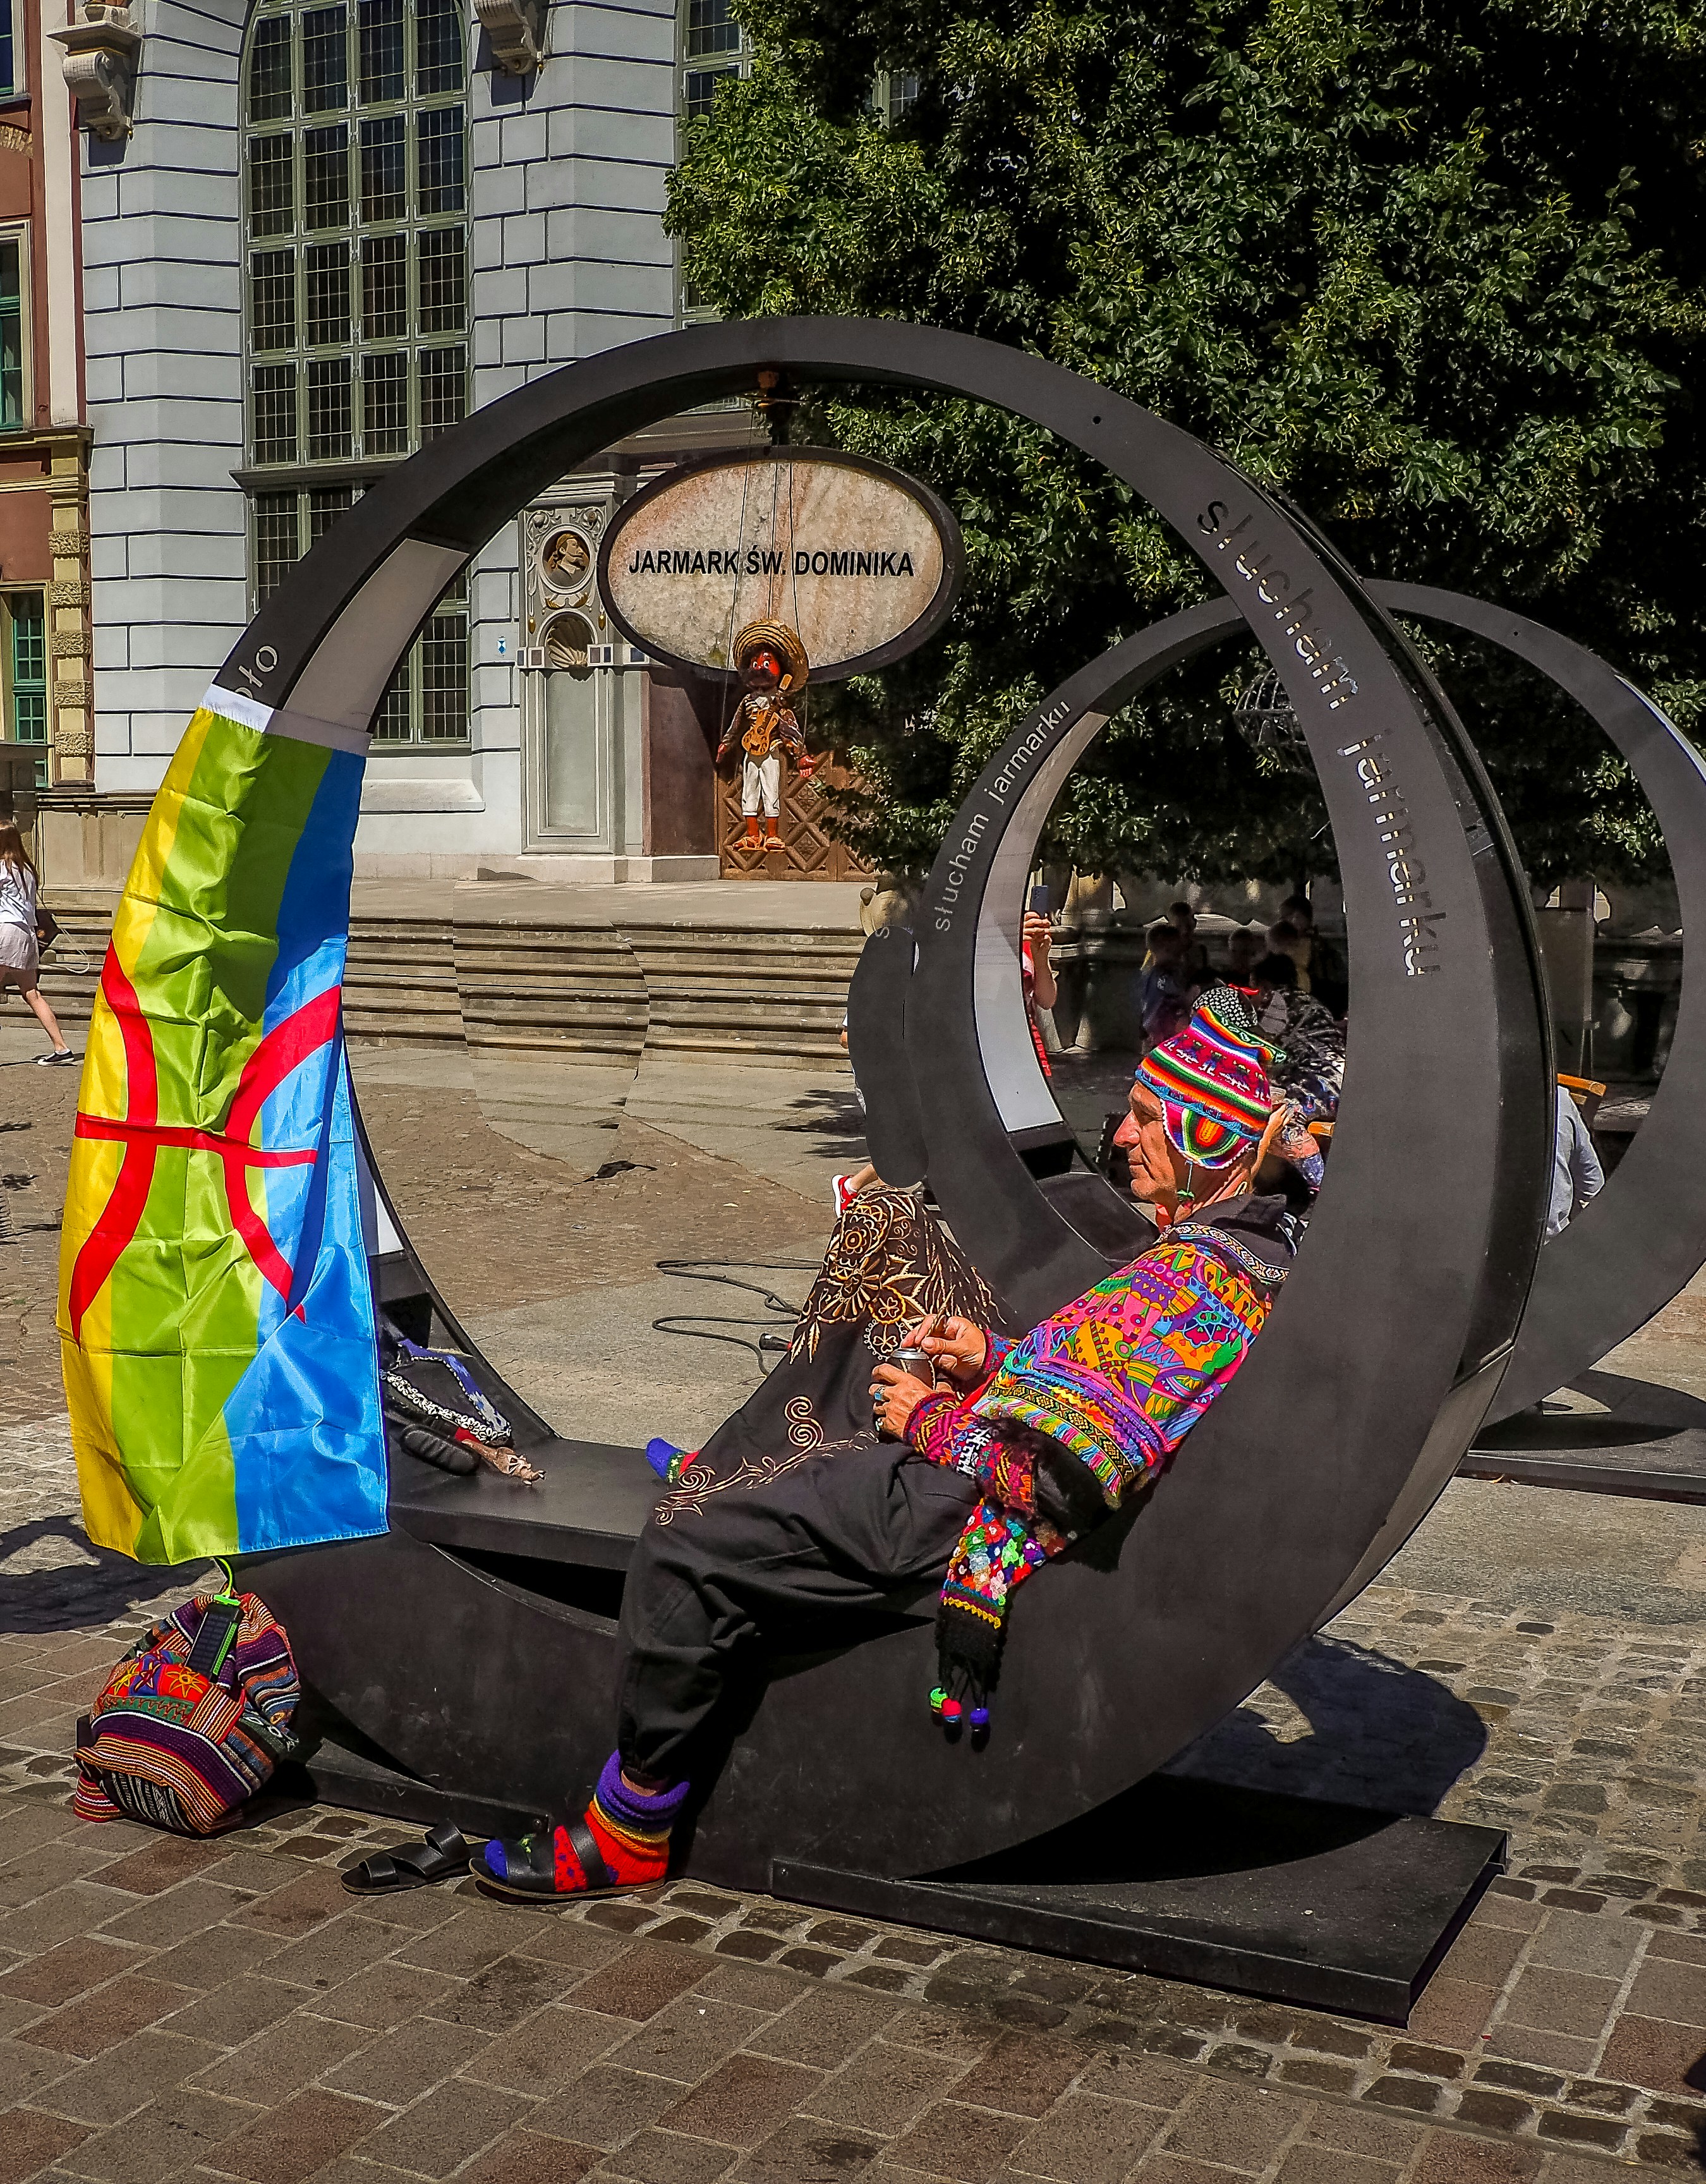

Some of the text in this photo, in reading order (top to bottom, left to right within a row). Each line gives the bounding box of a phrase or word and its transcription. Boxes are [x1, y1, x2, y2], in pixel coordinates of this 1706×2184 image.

[629, 546, 913, 576] JARMARK ŚW. DOMINIKA
[935, 701, 1070, 931] słucham jarmarku
[1197, 500, 1446, 976] słucham jarmarku
